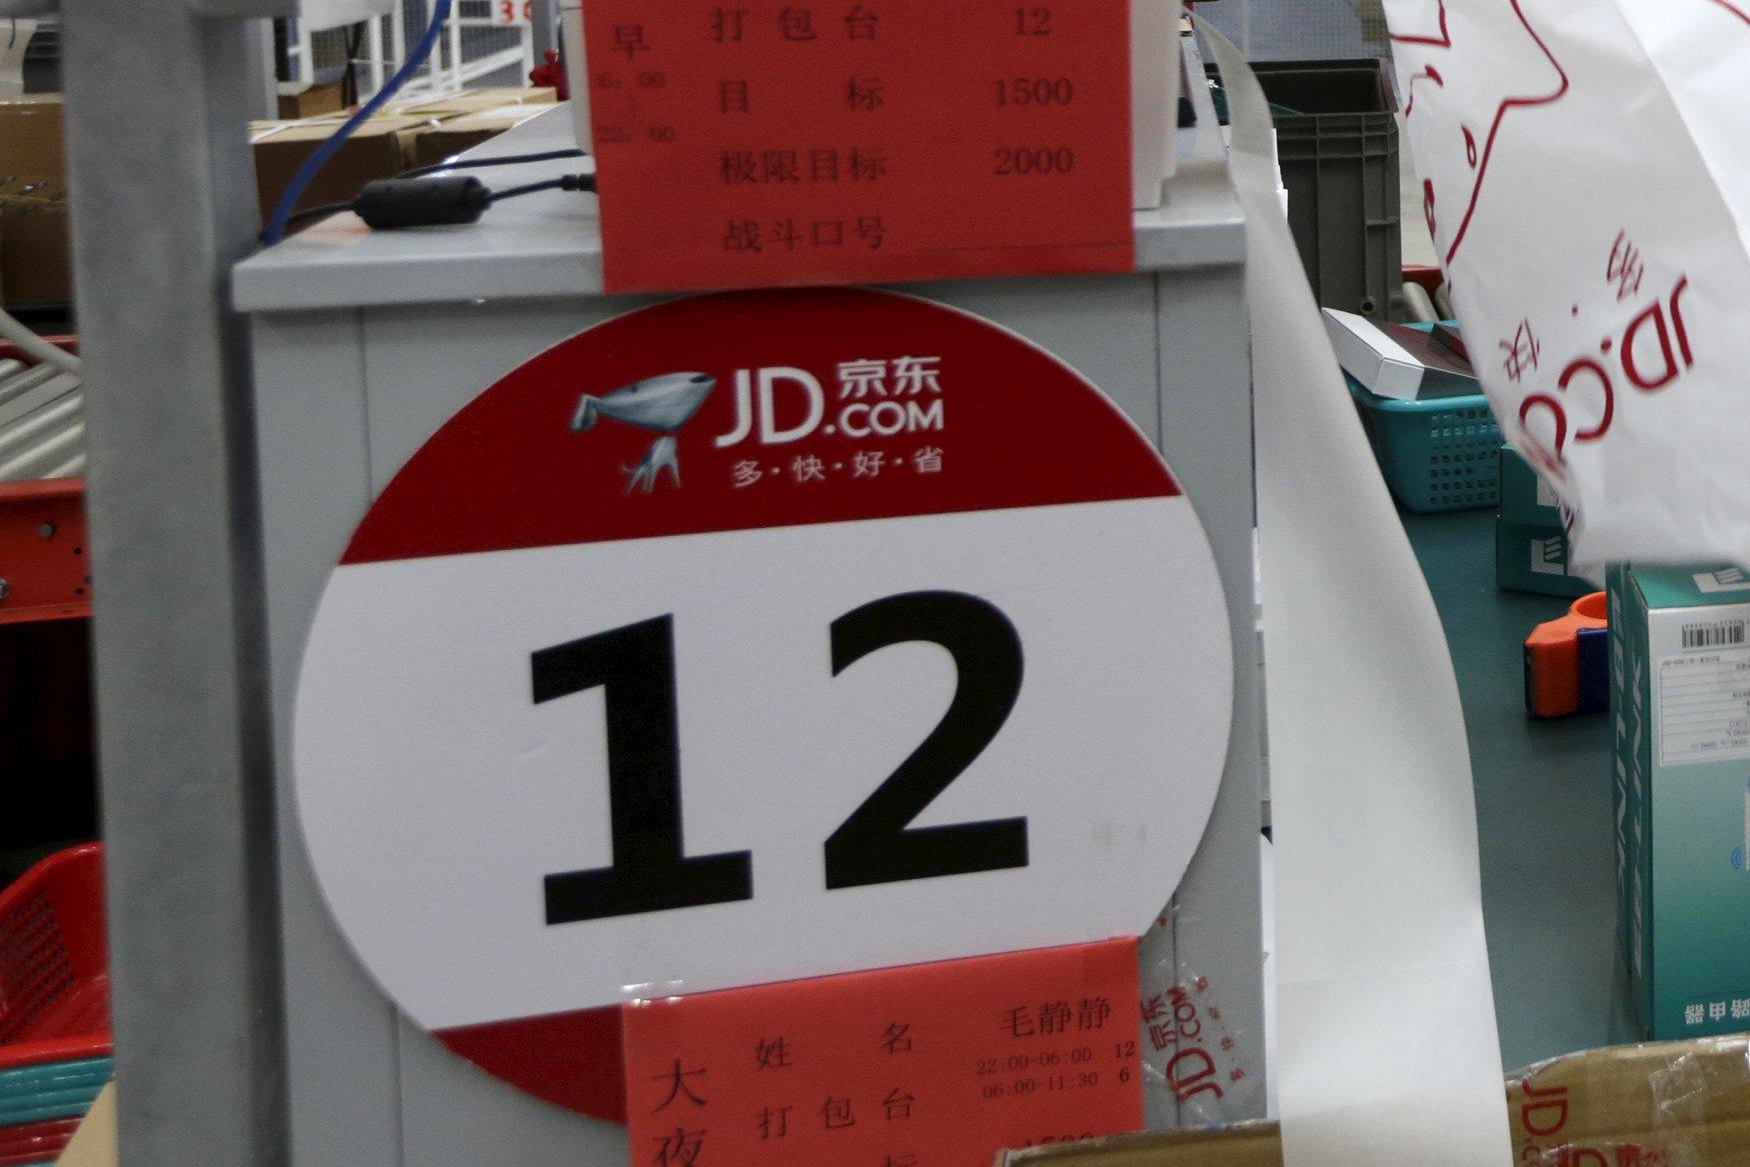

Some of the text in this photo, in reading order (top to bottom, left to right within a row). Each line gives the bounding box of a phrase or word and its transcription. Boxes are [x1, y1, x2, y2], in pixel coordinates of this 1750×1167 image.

[1013, 8, 1052, 37] 12
[611, 25, 651, 61] 早
[993, 78, 1073, 107] 1500
[720, 148, 1074, 183] 极限目标 2000
[724, 217, 887, 253] 战斗口号
[837, 355, 942, 399] 京东
[530, 589, 1029, 926] 12
[1003, 997, 1112, 1039] 毛静静
[1114, 1040, 1135, 1061] 12
[1118, 1065, 1131, 1085] 6
